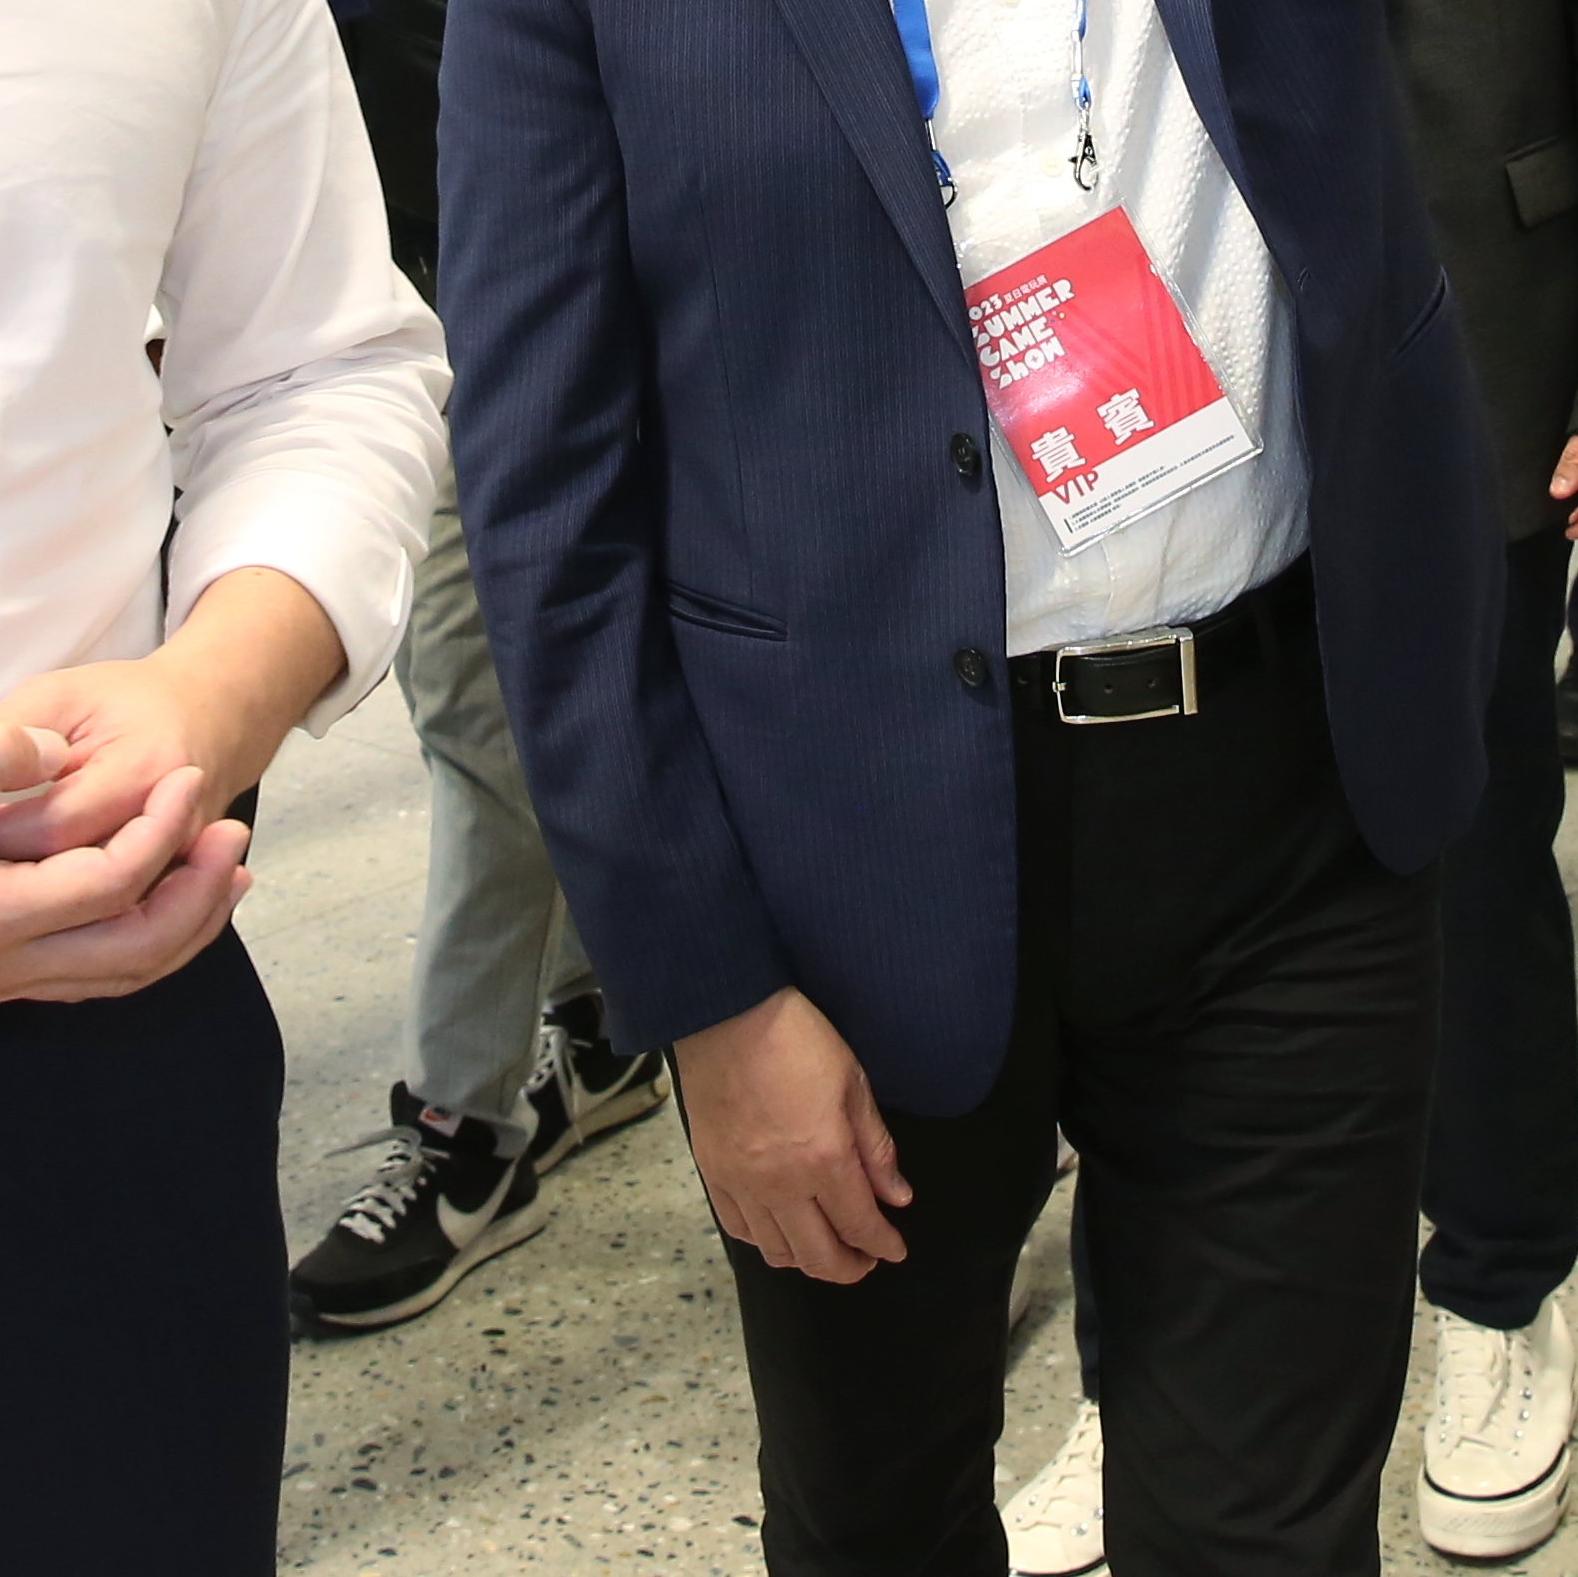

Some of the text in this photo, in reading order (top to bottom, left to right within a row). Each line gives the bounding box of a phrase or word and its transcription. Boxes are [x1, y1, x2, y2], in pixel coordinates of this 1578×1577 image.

[968, 293, 1003, 321] 023
[971, 278, 1076, 348] SUMMER
[979, 315, 1055, 367] GAME
[1029, 386, 1156, 484] 貴賓
[1050, 469, 1100, 505] VIP
